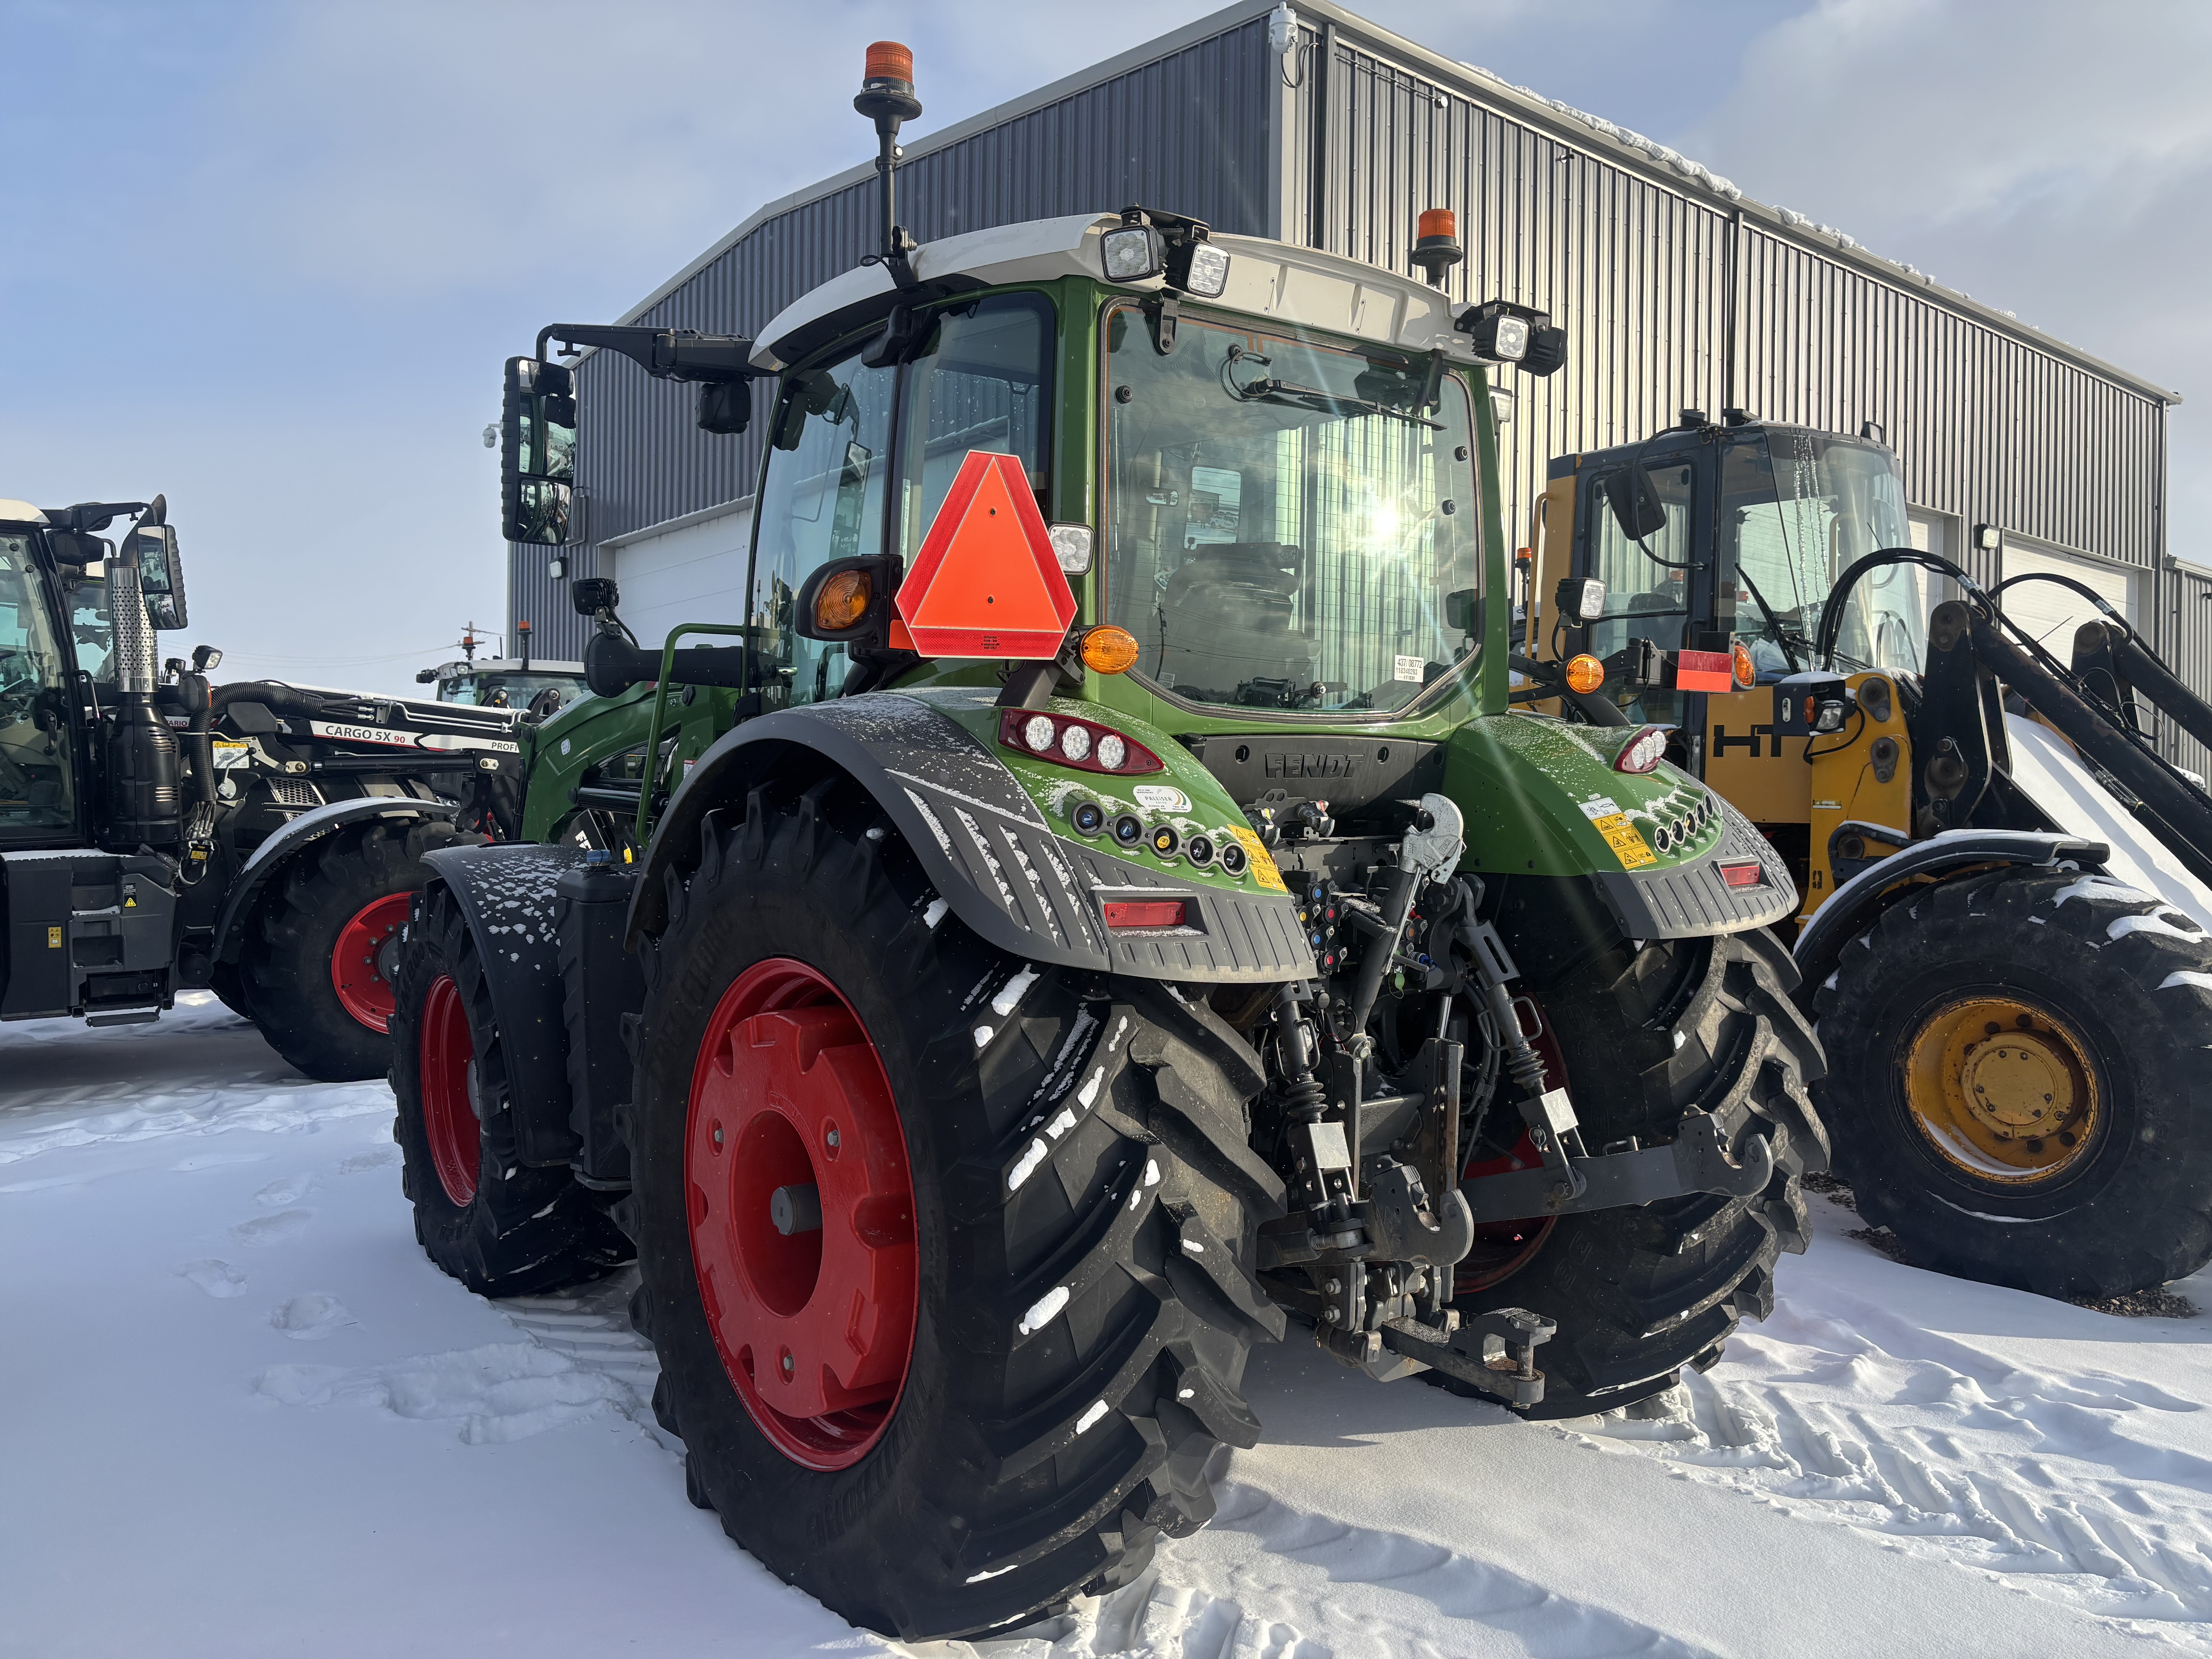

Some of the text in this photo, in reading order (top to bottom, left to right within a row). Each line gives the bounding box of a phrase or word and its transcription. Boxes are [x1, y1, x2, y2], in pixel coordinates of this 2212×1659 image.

[325, 725, 372, 739] CARGO
[375, 732, 391, 742] 5X
[491, 742, 517, 751] PROFI
[1265, 754, 1365, 778] FENDT
[575, 830, 593, 851] FE
[805, 1367, 937, 1547] TRELLEBORG
